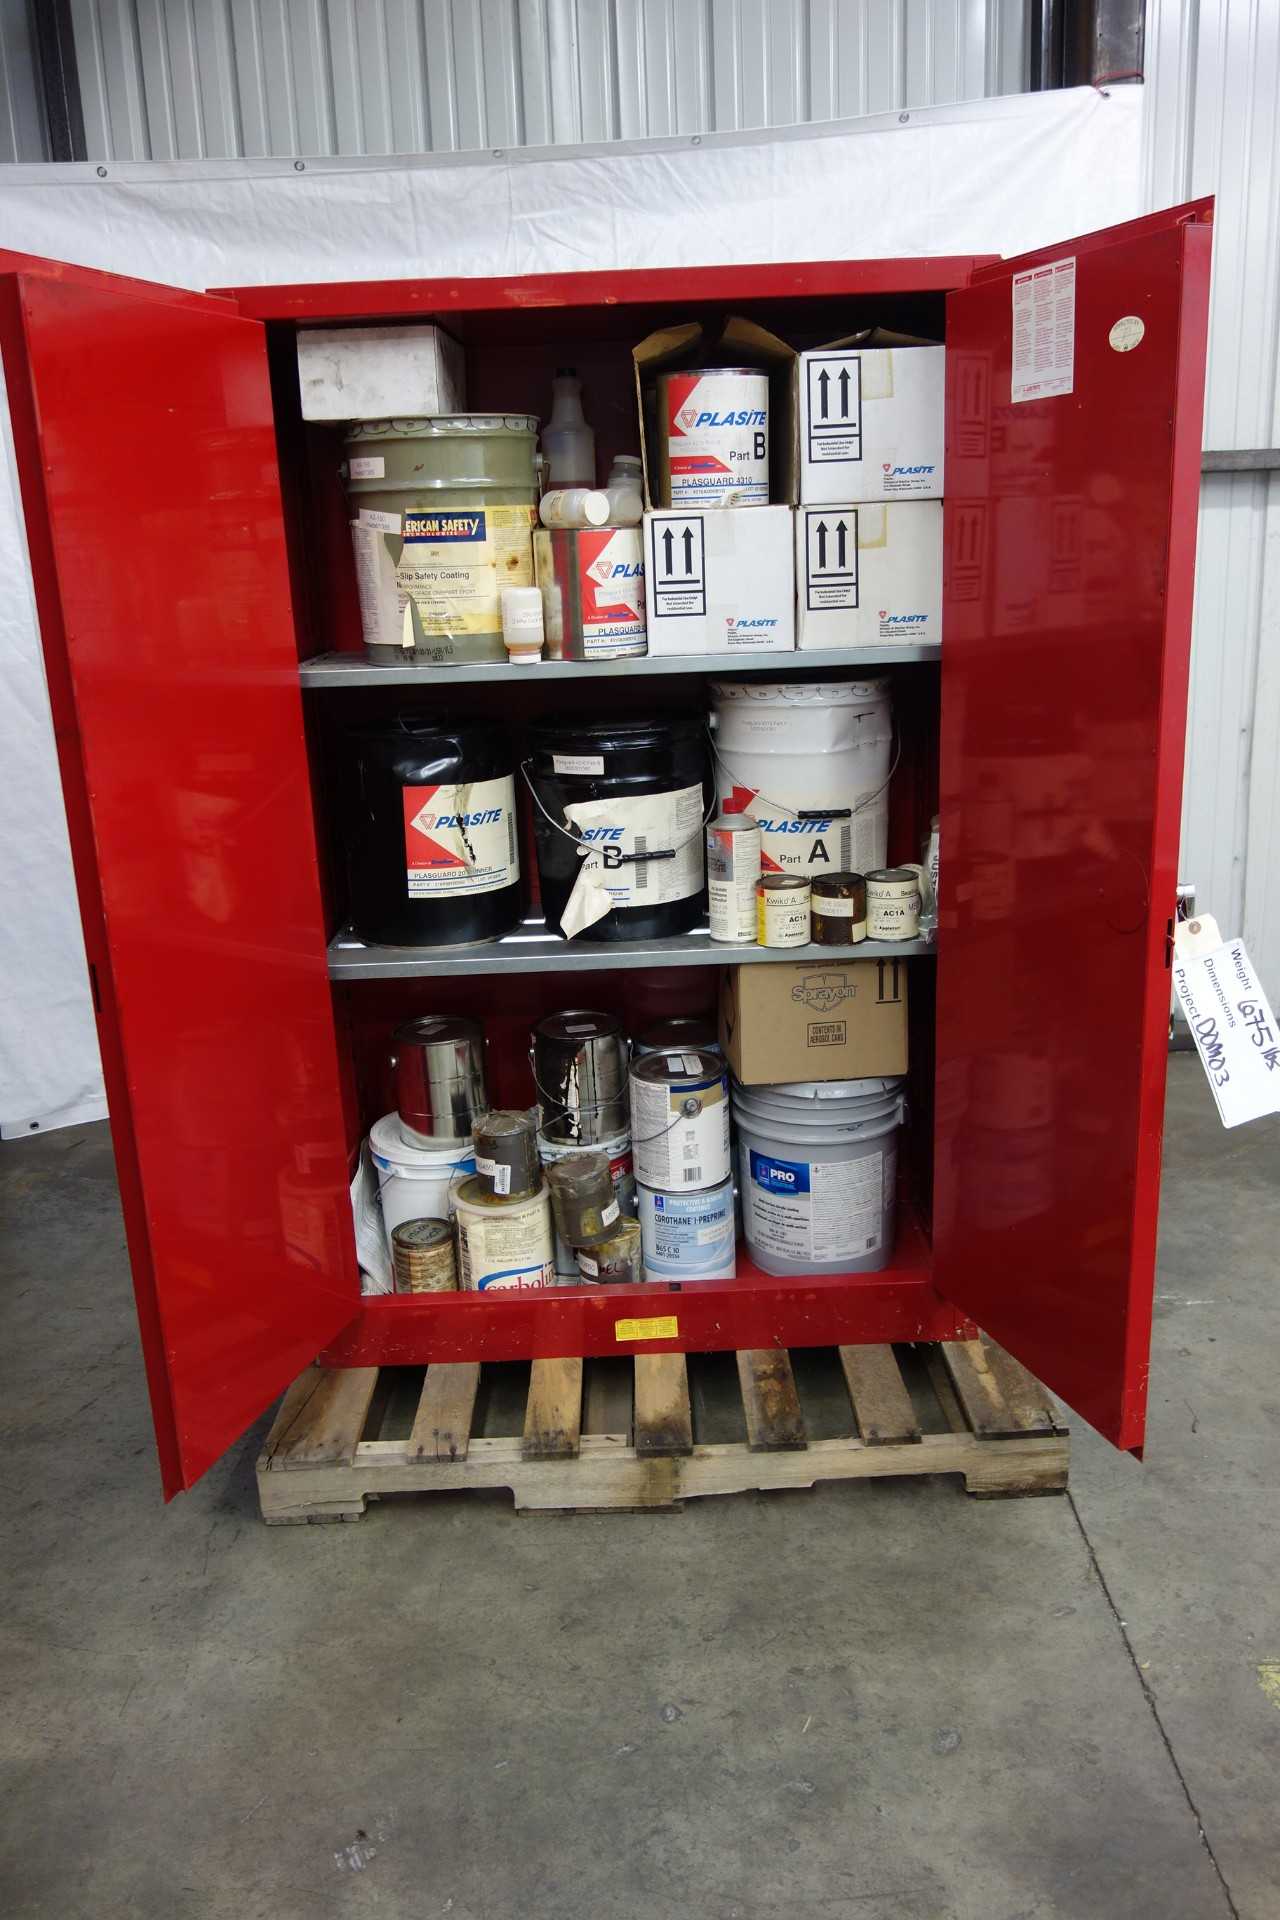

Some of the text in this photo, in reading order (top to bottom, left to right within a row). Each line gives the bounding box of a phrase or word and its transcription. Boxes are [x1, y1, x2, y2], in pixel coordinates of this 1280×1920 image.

[695, 410, 767, 427] PLASITE
[729, 432, 766, 460] Part B
[892, 466, 935, 475] PLASITE
[682, 478, 734, 487] PLASGUARD
[405, 519, 439, 532] ERICAN
[442, 518, 479, 535] SAFETY
[415, 571, 438, 581] Safety
[440, 571, 470, 580] Coating
[611, 563, 646, 578] PLAS
[736, 619, 778, 627] PLASITE
[888, 615, 928, 623] PLASITE
[435, 808, 502, 829] PLASITE
[757, 819, 832, 834] PLASITE
[579, 827, 625, 841] SITE
[602, 845, 624, 869] B
[779, 839, 831, 863] Part A
[1231, 948, 1252, 991] Weight
[792, 985, 857, 1004] Sprayon
[1175, 968, 1202, 1020] Project
[1203, 958, 1236, 1028] Dimensions
[1237, 1000, 1274, 1047] 675
[770, 1168, 795, 1183] PRO
[654, 1214, 692, 1225] COROTHANE
